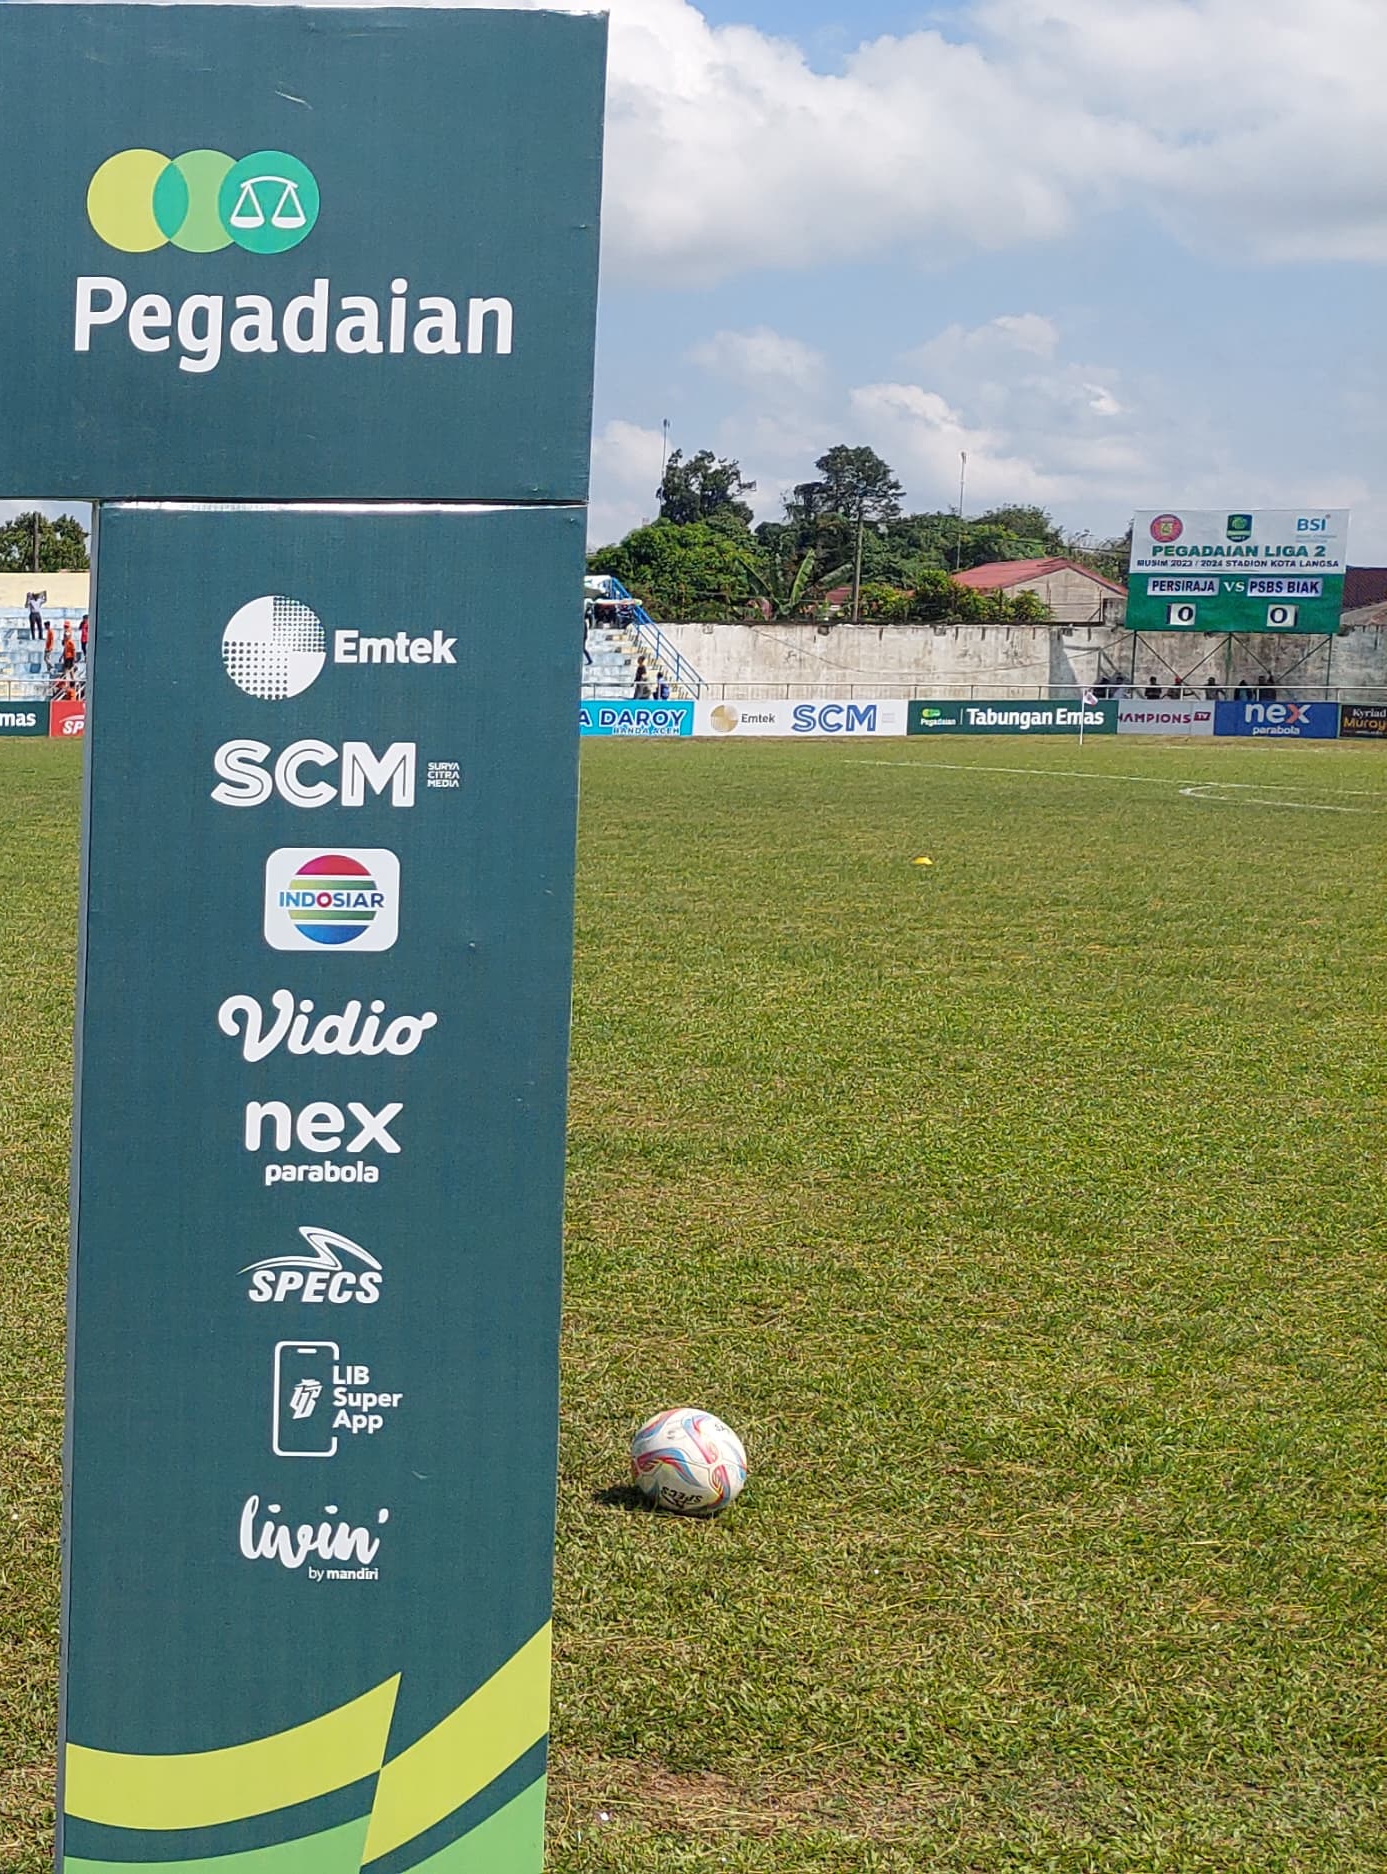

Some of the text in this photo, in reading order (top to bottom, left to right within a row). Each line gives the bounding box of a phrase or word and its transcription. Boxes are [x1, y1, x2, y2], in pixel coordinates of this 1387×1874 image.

[74, 275, 514, 374] Pegadaian
[1296, 518, 1326, 531] BSI
[1152, 545, 1326, 557] PEGADAIAN LIGA 2
[1136, 559, 1168, 567] MUSIM
[1151, 579, 1320, 594] PERSIRAJA VS PSBS BIAK
[334, 629, 458, 664] Emtek
[600, 709, 686, 726] DAROY
[741, 713, 776, 724] Emtek
[791, 704, 878, 732] SCM
[966, 708, 1105, 730] Tabungan Emas
[1118, 712, 1192, 724] HAMPIONS
[1244, 702, 1312, 725] nex
[1352, 708, 1387, 719] Kyriad
[1252, 725, 1300, 736] parabola
[210, 738, 417, 808] SCM
[427, 761, 460, 771] SURYA
[427, 771, 460, 779] CITRA
[427, 779, 460, 788] MEDIA
[278, 891, 385, 909] INDOSIAR
[217, 988, 438, 1063] Vidio
[244, 1100, 404, 1154] nex
[264, 1160, 380, 1187] parabola
[248, 1270, 383, 1304] SPECS
[331, 1365, 370, 1386] LIB
[332, 1387, 403, 1413] Super
[332, 1408, 383, 1434] App
[239, 1494, 390, 1569] livin'
[308, 1566, 379, 1582] by mandiri
